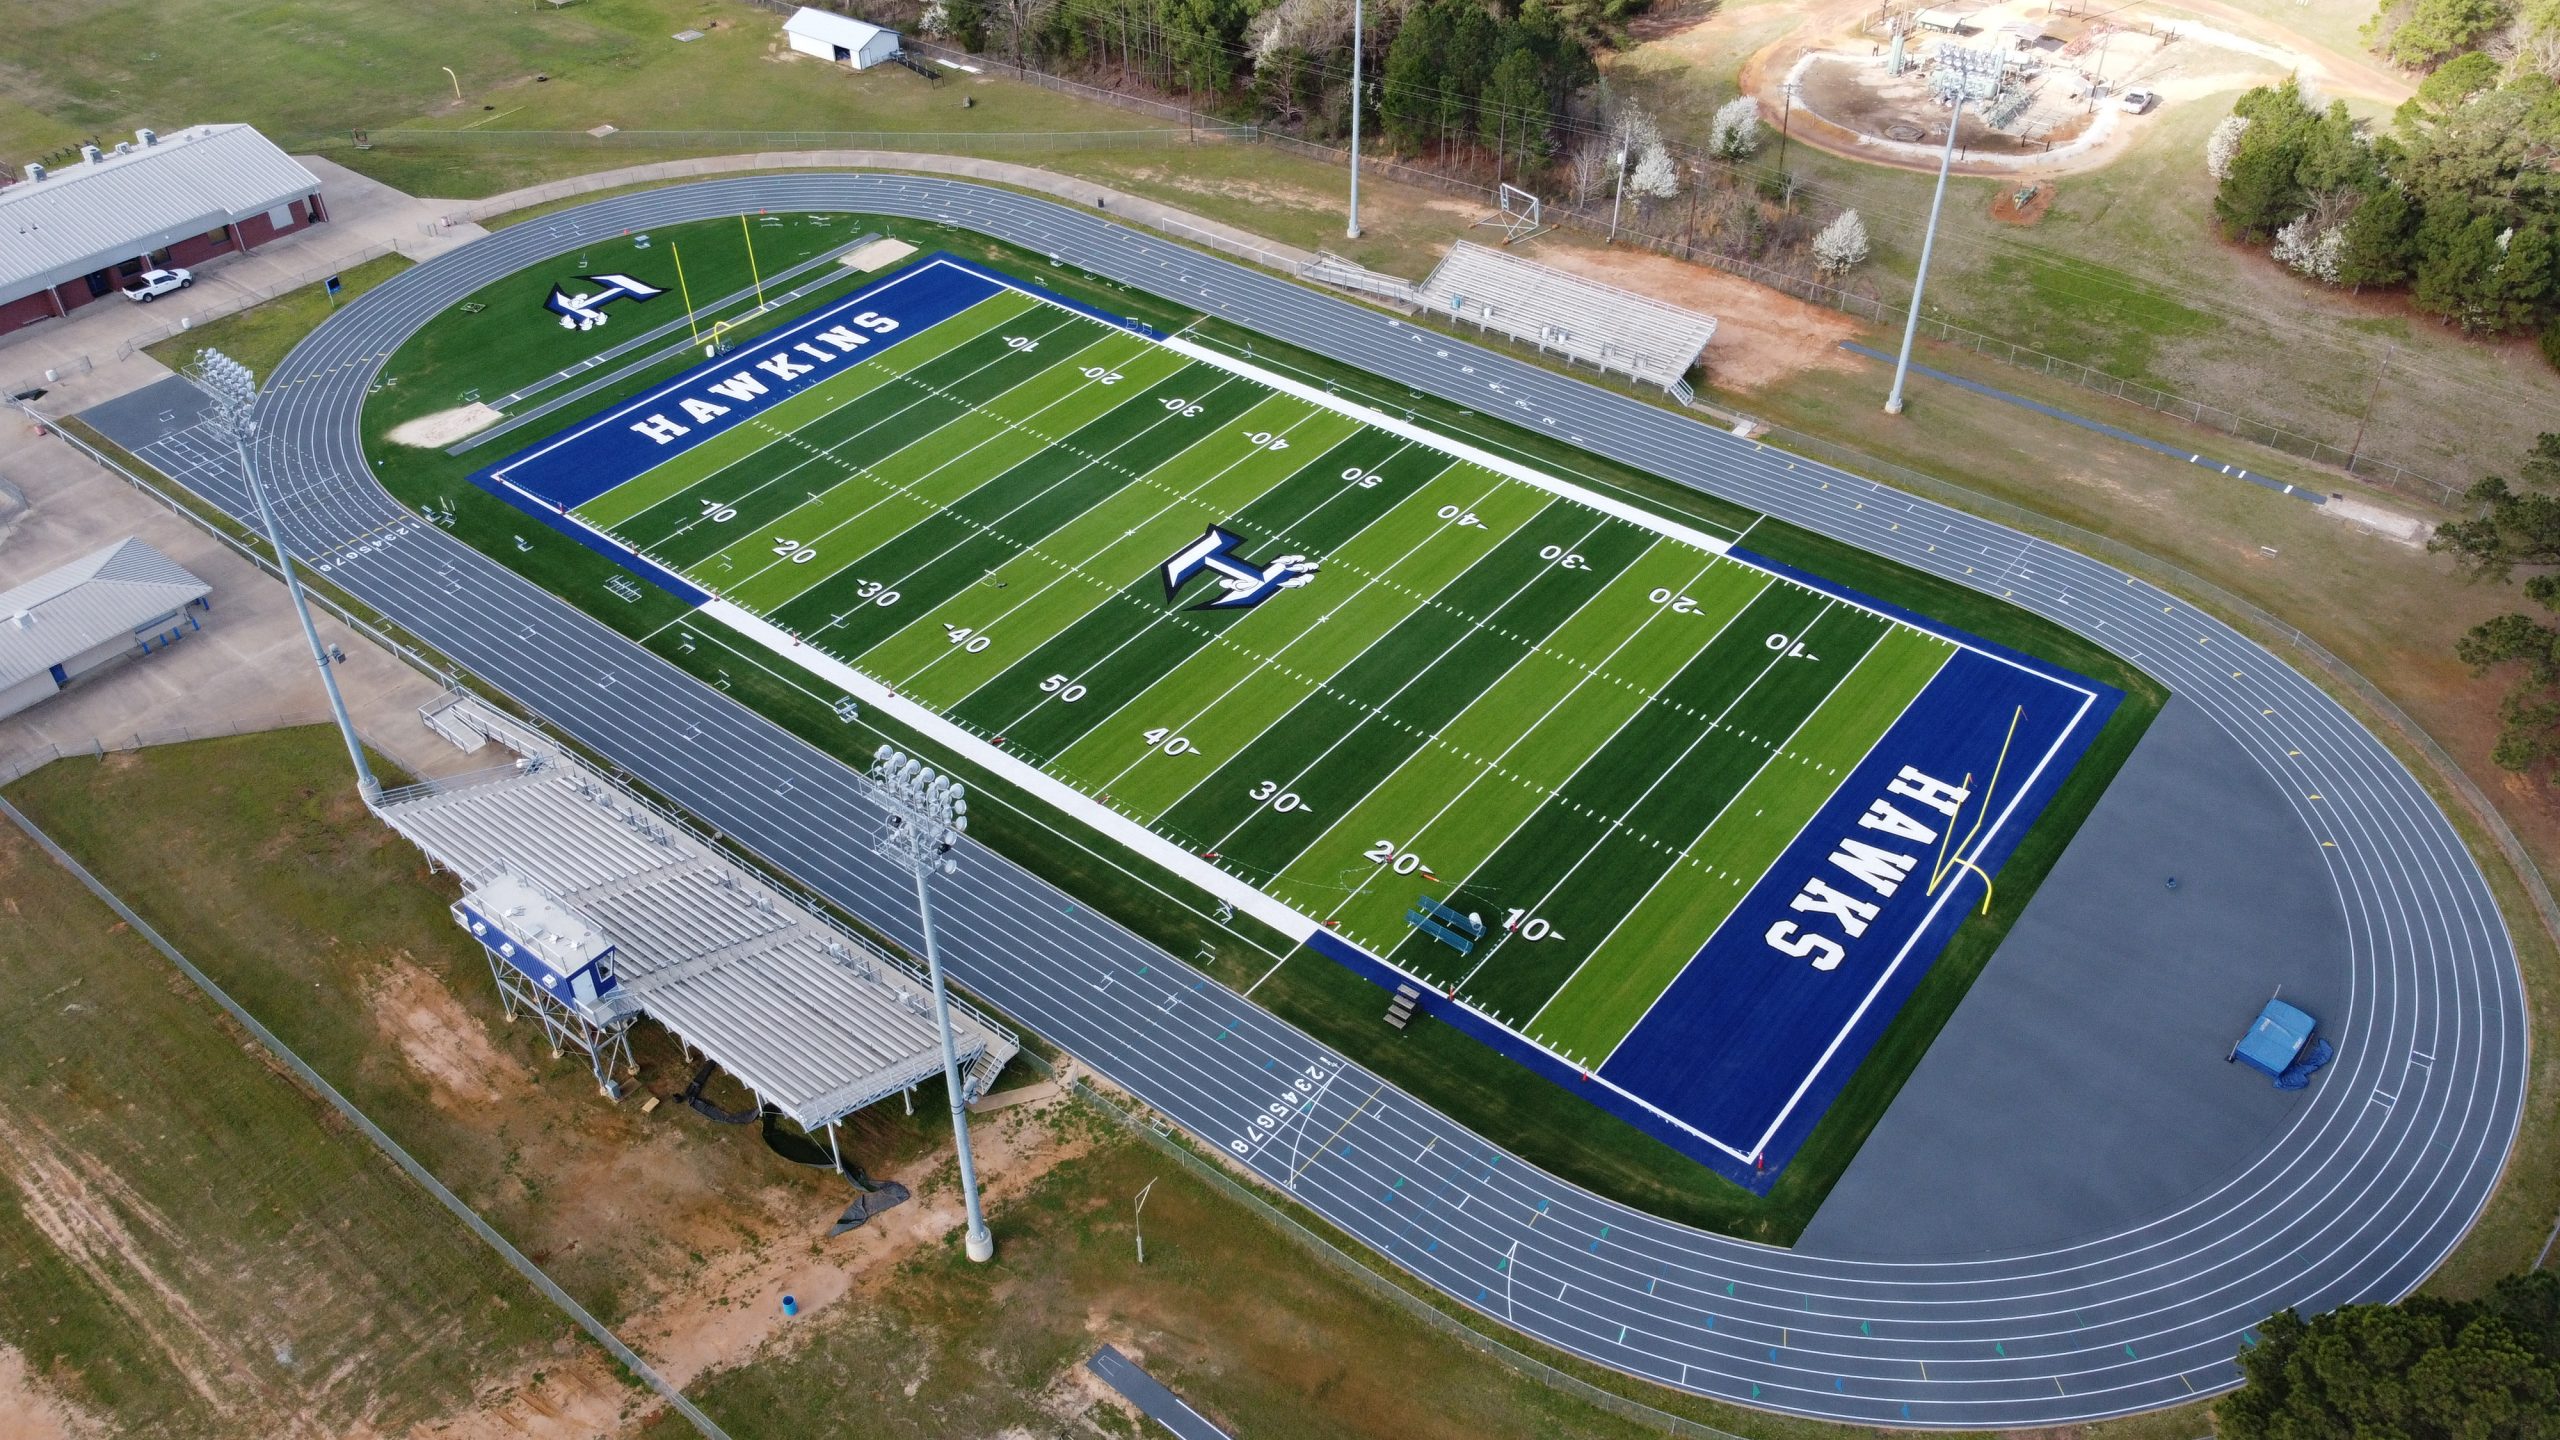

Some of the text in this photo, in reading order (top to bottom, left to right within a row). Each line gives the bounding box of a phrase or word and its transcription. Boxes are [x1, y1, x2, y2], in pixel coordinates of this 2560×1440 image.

[1008, 336, 1040, 352] 10
[629, 311, 900, 445] HAWKINS
[1084, 367, 1125, 385] 20
[1165, 398, 1204, 418] 30
[1251, 432, 1290, 451] 40
[1341, 467, 1382, 489] 50
[701, 502, 738, 522] 10
[1437, 505, 1480, 527] 40
[772, 540, 817, 564] 20
[1539, 545, 1585, 569] 30
[857, 582, 900, 607] 30
[1648, 588, 1698, 614] 20
[948, 628, 991, 653] 40
[1765, 633, 1806, 658] 10
[1039, 674, 1087, 702] 50
[1142, 728, 1190, 756] 40
[1249, 780, 1300, 813] 30
[1362, 840, 1420, 876] 20
[1764, 764, 1972, 972] HAWKS
[1502, 908, 1550, 942] 10
[1305, 1066, 1324, 1080] 2
[1294, 1078, 1312, 1092] 3
[1282, 1092, 1298, 1104] 4
[1256, 1114, 1274, 1128] 6
[1270, 1102, 1290, 1118] 5
[1247, 1126, 1264, 1142] 7
[1230, 1140, 1248, 1154] 8
